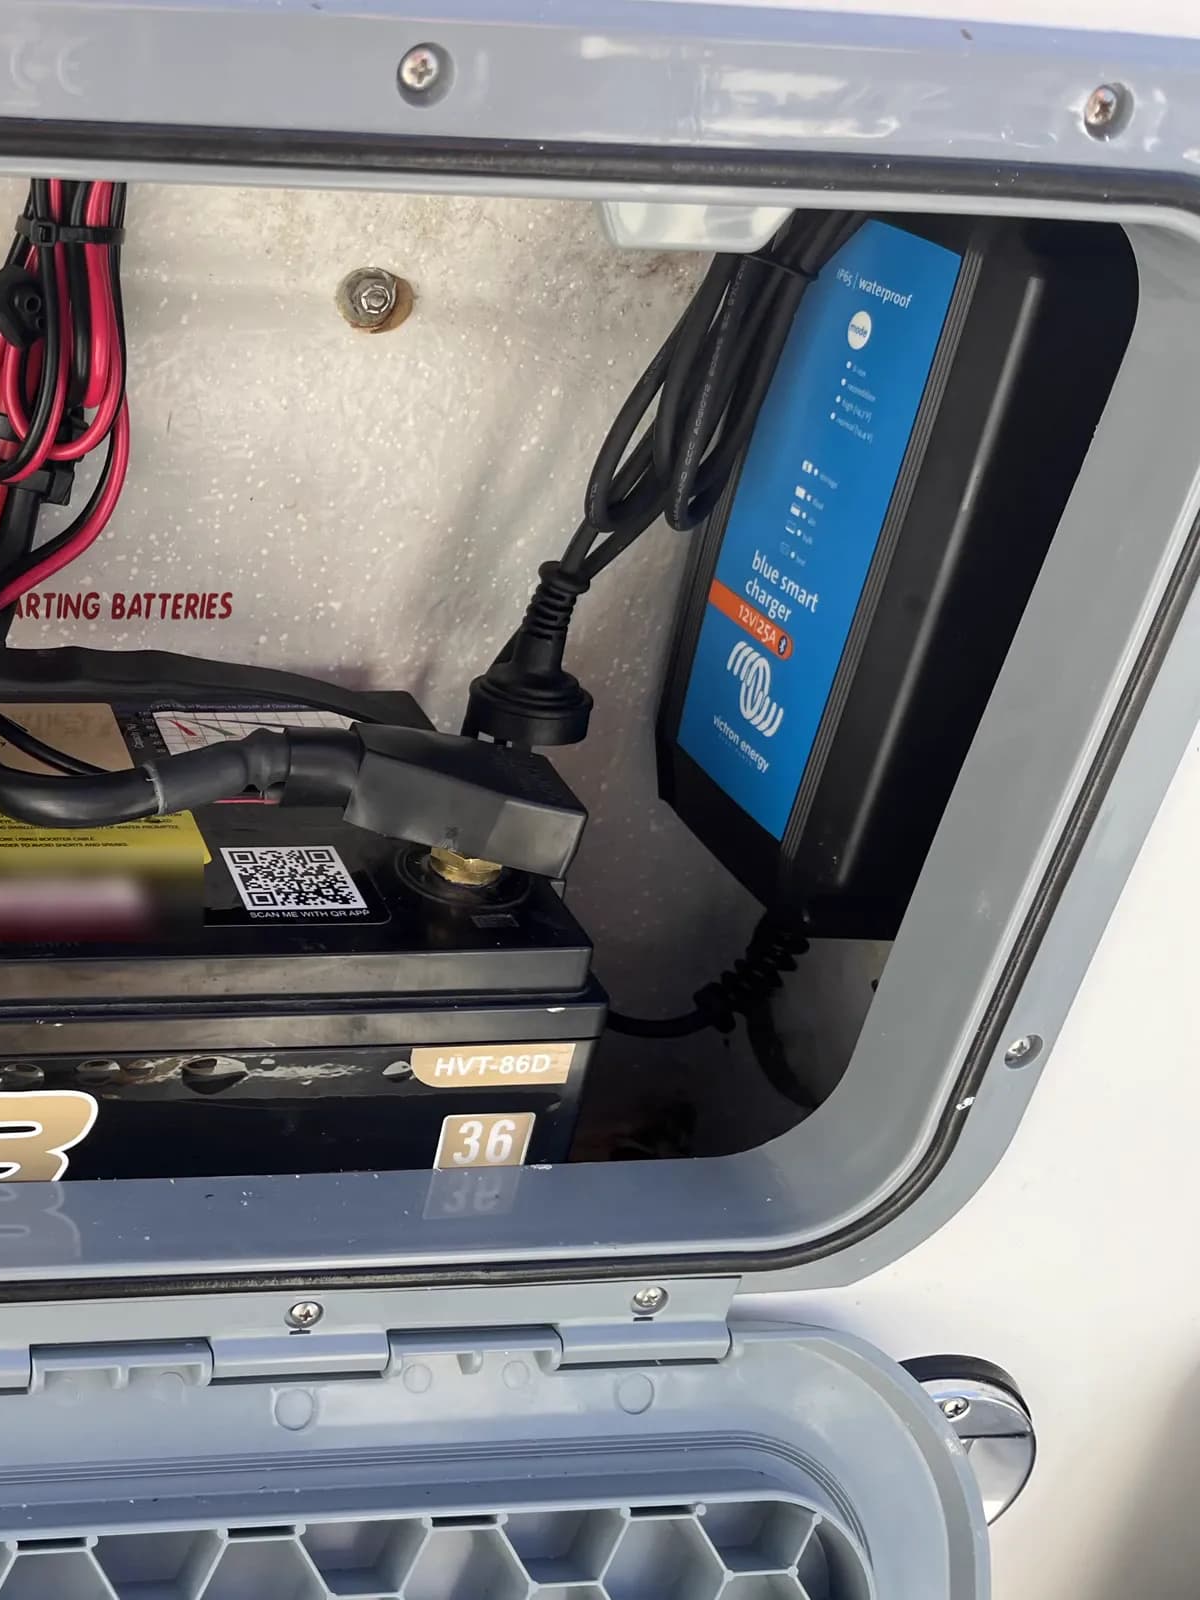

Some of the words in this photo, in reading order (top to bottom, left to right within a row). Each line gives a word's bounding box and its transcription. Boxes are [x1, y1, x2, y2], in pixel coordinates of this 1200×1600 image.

[859, 278, 913, 309] waterproof
[850, 323, 868, 338] mode
[751, 549, 780, 585] blue
[780, 575, 819, 613] smart
[15, 592, 101, 620] ARTING
[111, 592, 233, 620] BATTERIES
[745, 577, 792, 622] charger
[713, 714, 740, 745] victron
[740, 740, 769, 774] energy
[250, 911, 280, 919] SCAN
[300, 910, 329, 918] WITH
[349, 908, 370, 916] APP
[434, 1054, 551, 1077] HVT-86D
[452, 1119, 517, 1165] 36
